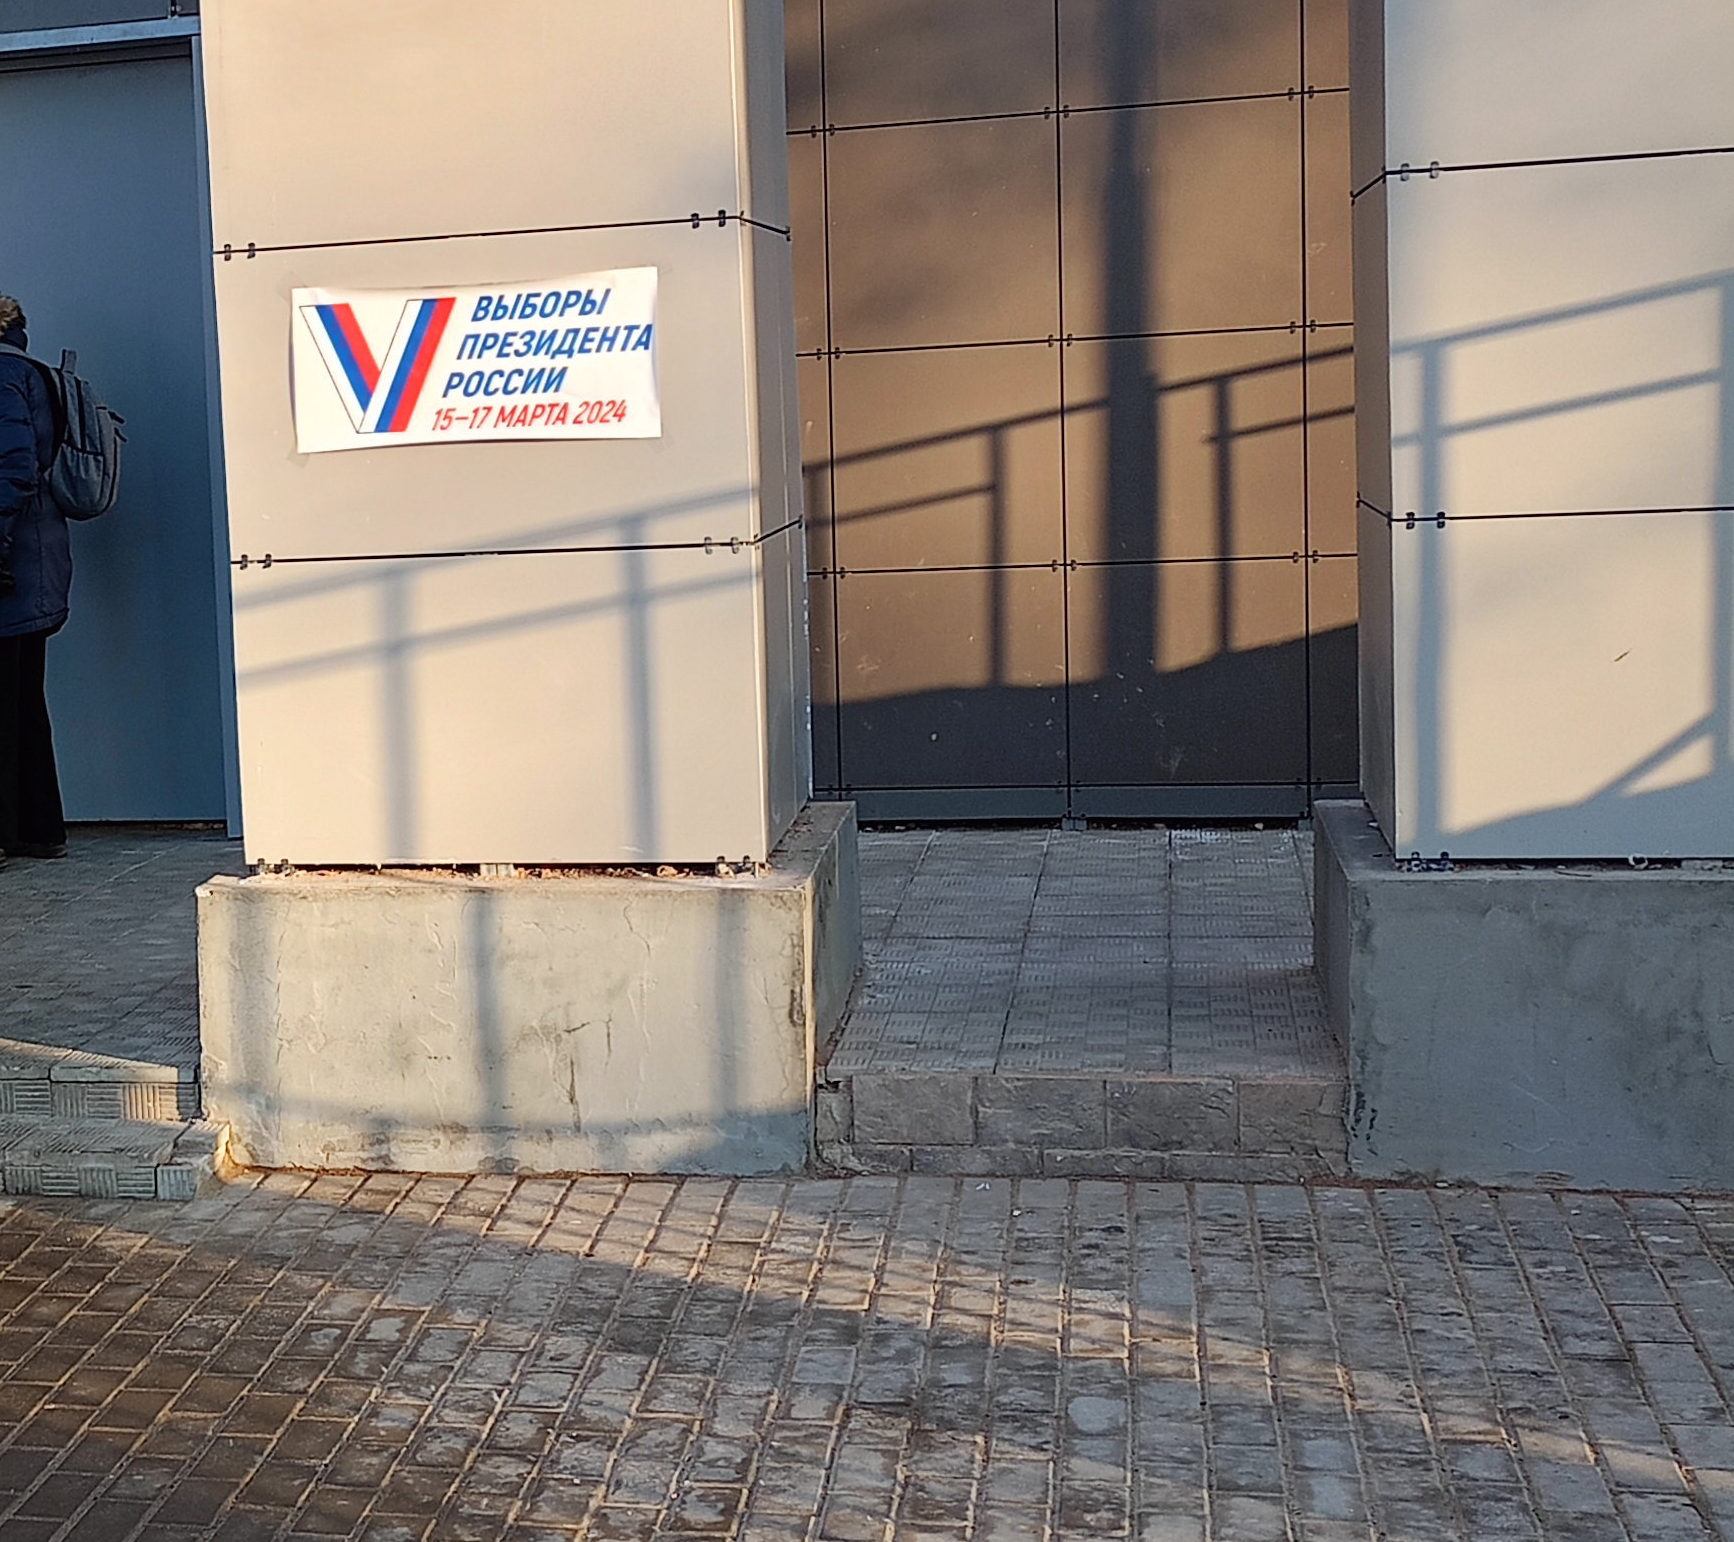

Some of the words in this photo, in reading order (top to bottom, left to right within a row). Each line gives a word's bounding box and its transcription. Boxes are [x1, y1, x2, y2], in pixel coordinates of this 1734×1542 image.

[472, 289, 610, 323] ВЫБОРЫ
[456, 324, 653, 360] ПРЕЗИДЕНТА
[442, 367, 568, 398] РОССИИ
[495, 403, 568, 428] МАРТА
[573, 400, 627, 424] 2024
